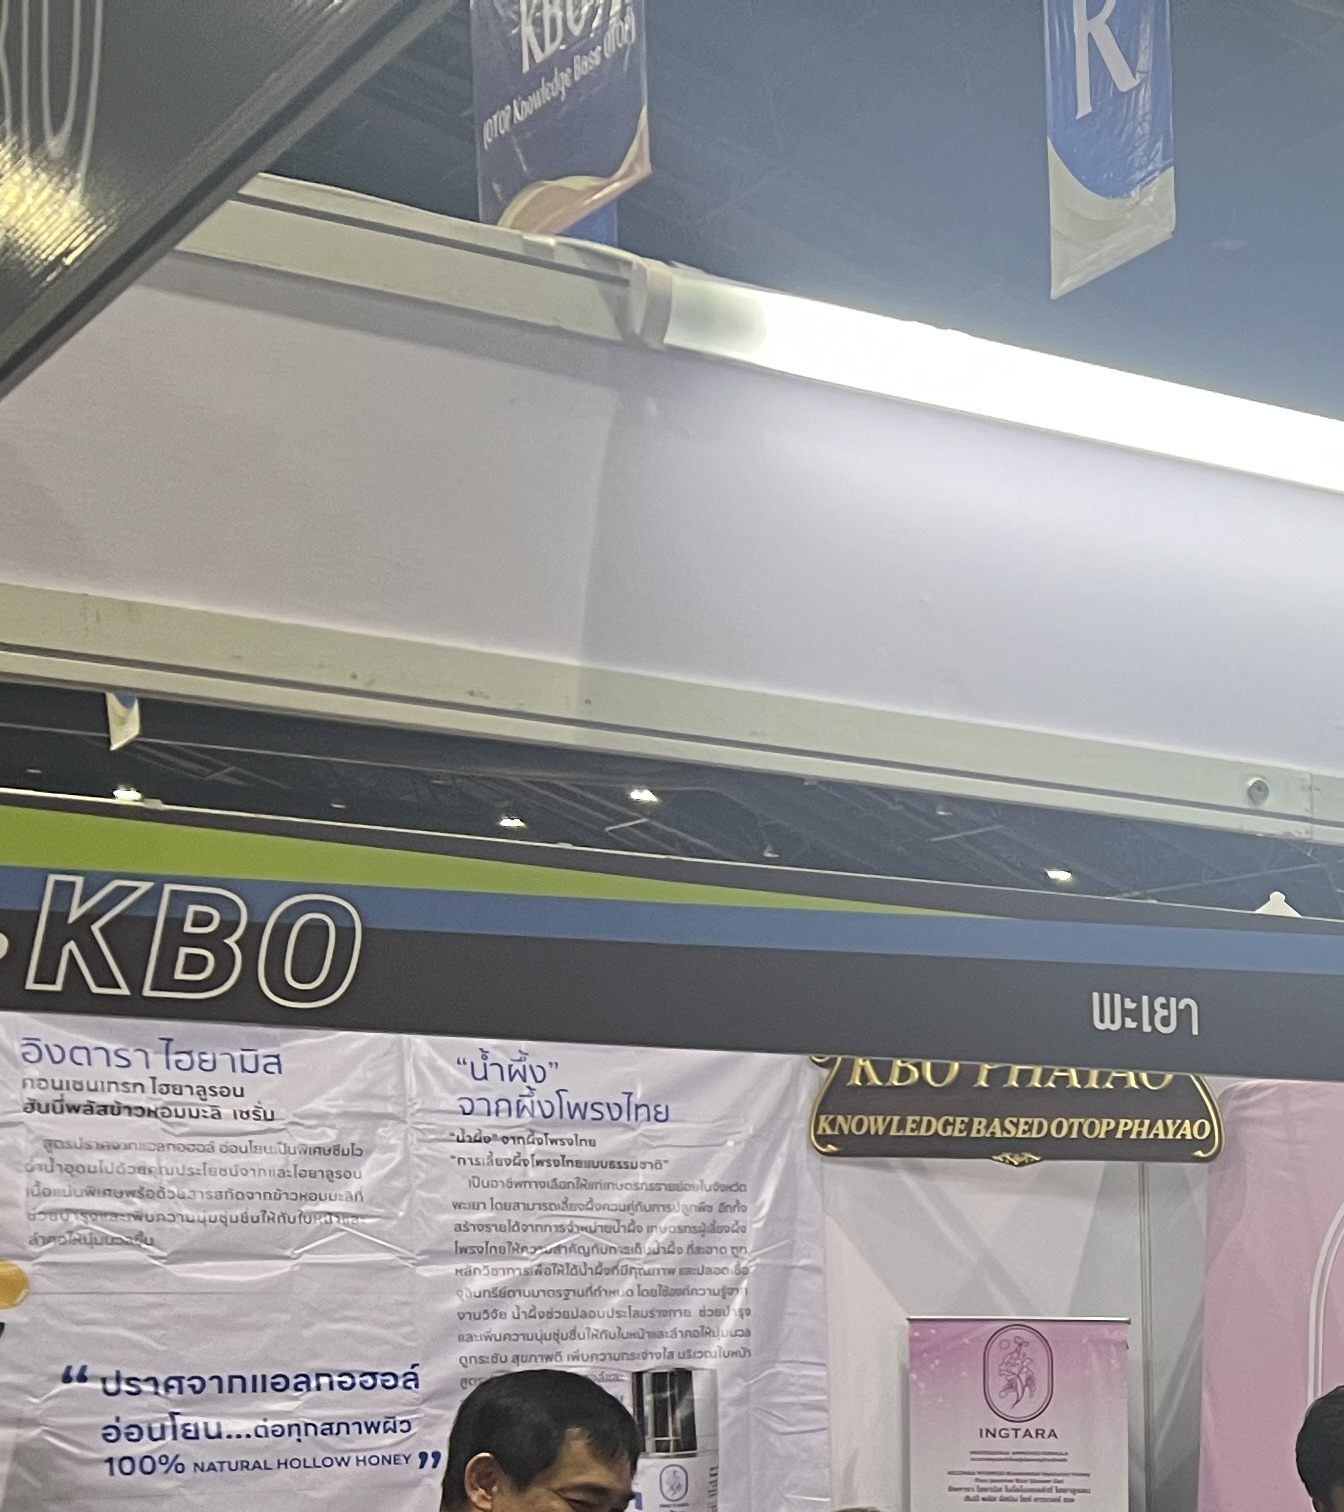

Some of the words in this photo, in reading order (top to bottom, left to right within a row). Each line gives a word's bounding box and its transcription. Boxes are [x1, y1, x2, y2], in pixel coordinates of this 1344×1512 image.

[25, 873, 364, 1009] KBO
[1091, 991, 1199, 1035] พะเยา
[21, 1037, 150, 1069] อิงตารา
[159, 1037, 283, 1075] ไฮยามิส
[458, 1085, 670, 1123] จากผึ้งโพรงไทย
[816, 1114, 968, 1138] KNOWLEDGE
[970, 1117, 1049, 1139] BASED
[1050, 1118, 1116, 1140] OTOP
[1115, 1118, 1210, 1141] PHAYAO
[101, 1363, 420, 1397] ปราศจากแอลกอฮอล์
[979, 1428, 1059, 1440] INGTARA
[103, 1454, 185, 1477] 100%
[193, 1458, 272, 1474] NATURAL
[277, 1455, 351, 1470] HOLLOW
[355, 1453, 413, 1467] HONEY
